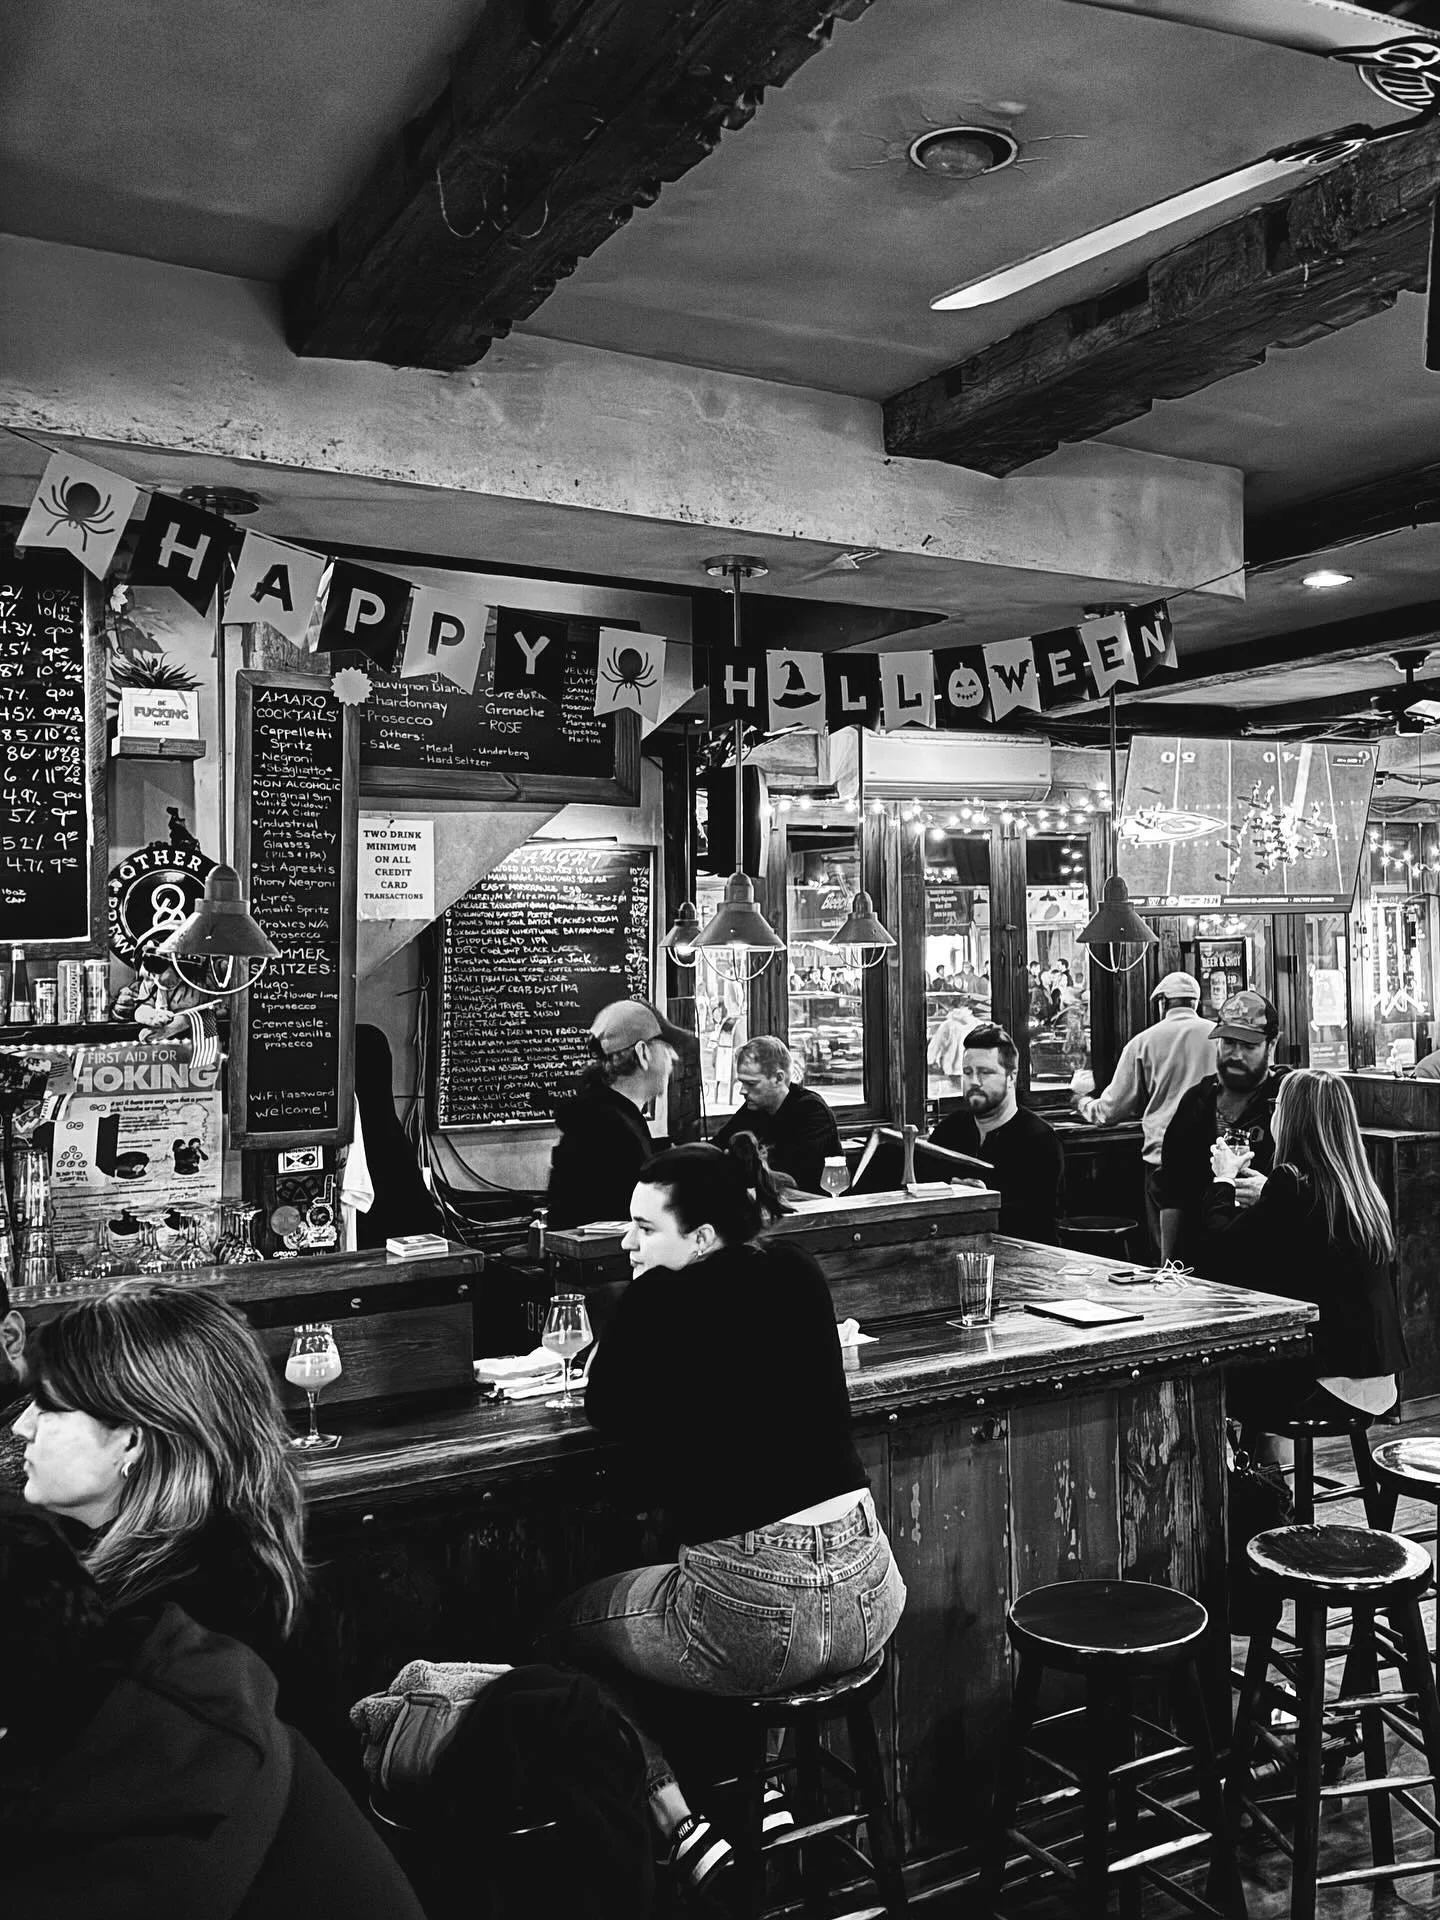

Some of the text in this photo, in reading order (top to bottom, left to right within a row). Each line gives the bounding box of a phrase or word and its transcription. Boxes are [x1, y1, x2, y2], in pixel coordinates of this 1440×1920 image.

[565, 667, 596, 676] VELVE
[257, 690, 326, 708] AMARO
[134, 706, 189, 720] FUCKING
[485, 702, 545, 718] Grenache
[367, 709, 433, 726] Prosecco
[270, 738, 312, 753] Spritz
[370, 739, 401, 751] Sake
[426, 744, 454, 753] Mead
[427, 755, 453, 765] Hard
[263, 830, 336, 844] Arts Safety
[363, 830, 421, 839] TWO DRINK
[366, 843, 416, 851] MINIMUM
[120, 849, 202, 880] OTHER
[392, 856, 411, 864] ALL
[375, 868, 412, 876] CREDIT
[381, 881, 408, 889] CARD
[280, 948, 331, 961] MMER
[87, 1050, 177, 1064] FIRST AID FOR
[76, 1063, 219, 1093] HOKING
[678, 1818, 695, 1838] NIKE
